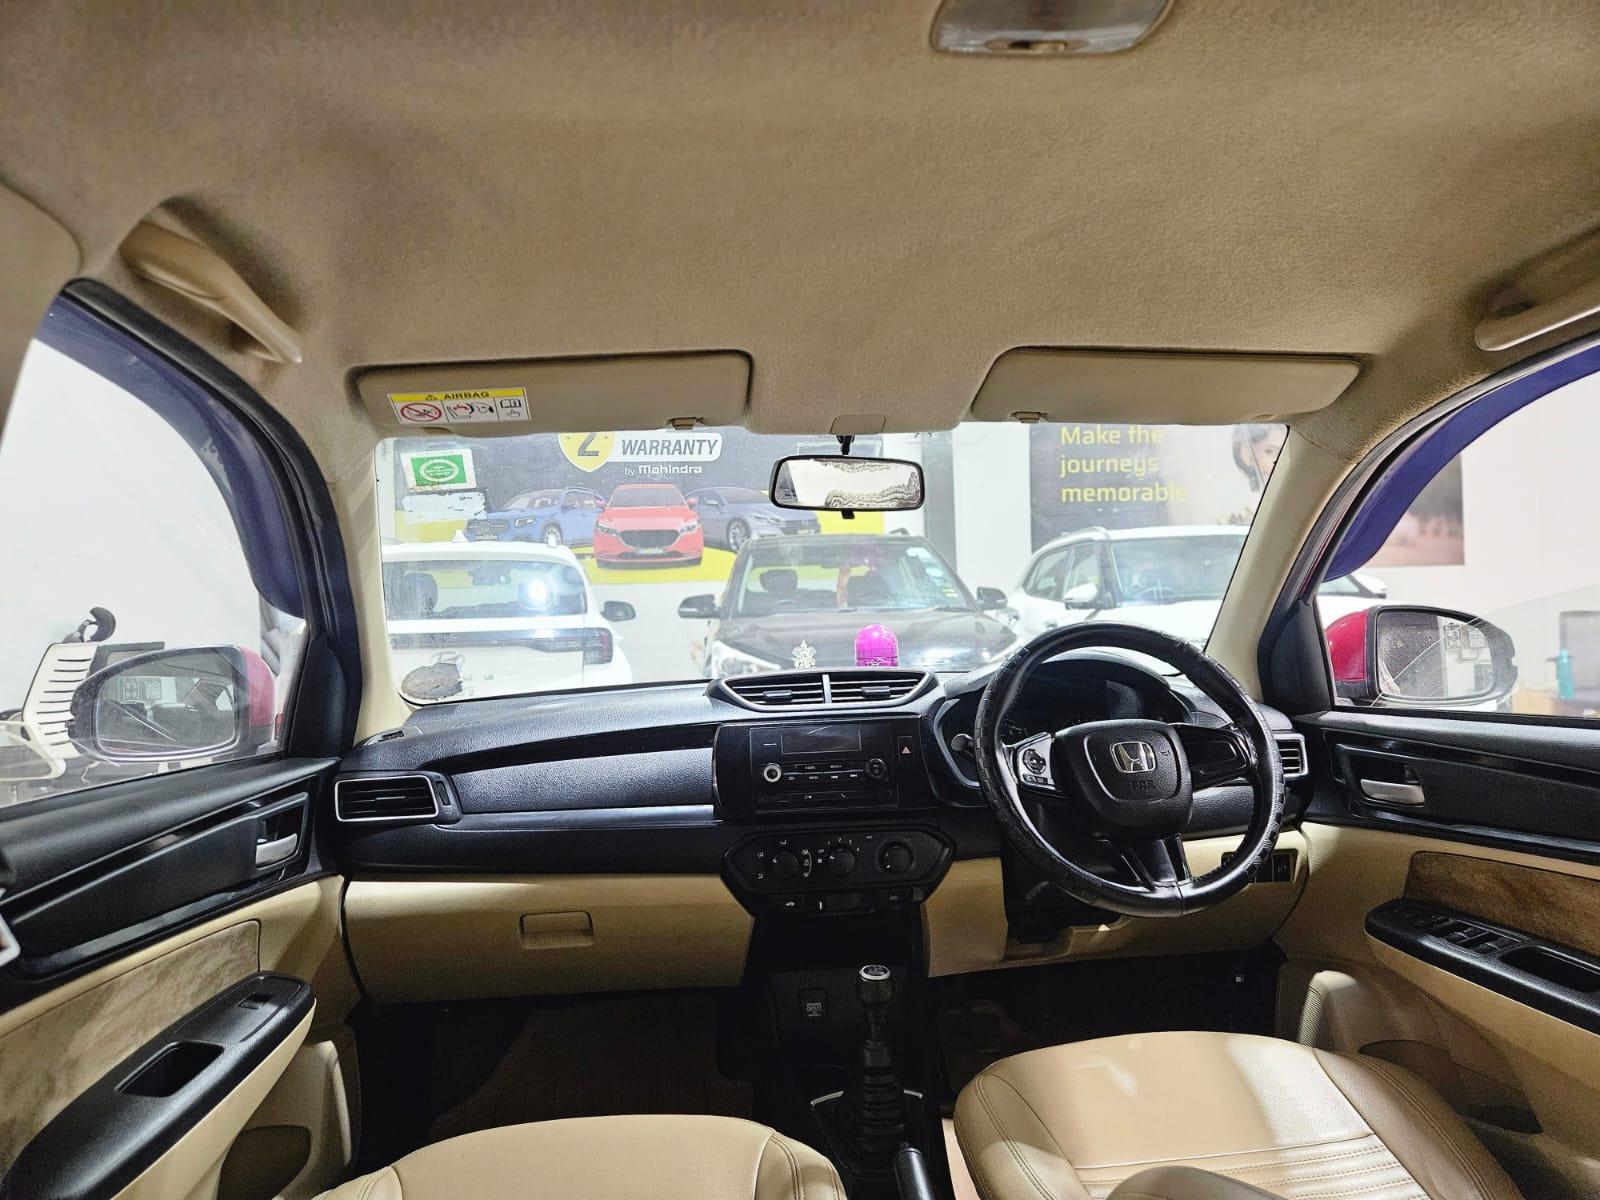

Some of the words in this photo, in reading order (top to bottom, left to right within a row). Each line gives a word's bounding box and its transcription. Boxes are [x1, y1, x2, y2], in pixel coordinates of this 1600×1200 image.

[444, 391, 490, 400] AIRBAG
[1060, 424, 1121, 445] Make
[1127, 425, 1165, 444] the
[621, 439, 719, 456] WARRANTY
[624, 467, 636, 476] by
[638, 464, 703, 475] Mahindra
[1060, 454, 1160, 478] journeys
[1061, 482, 1189, 502] memorable
